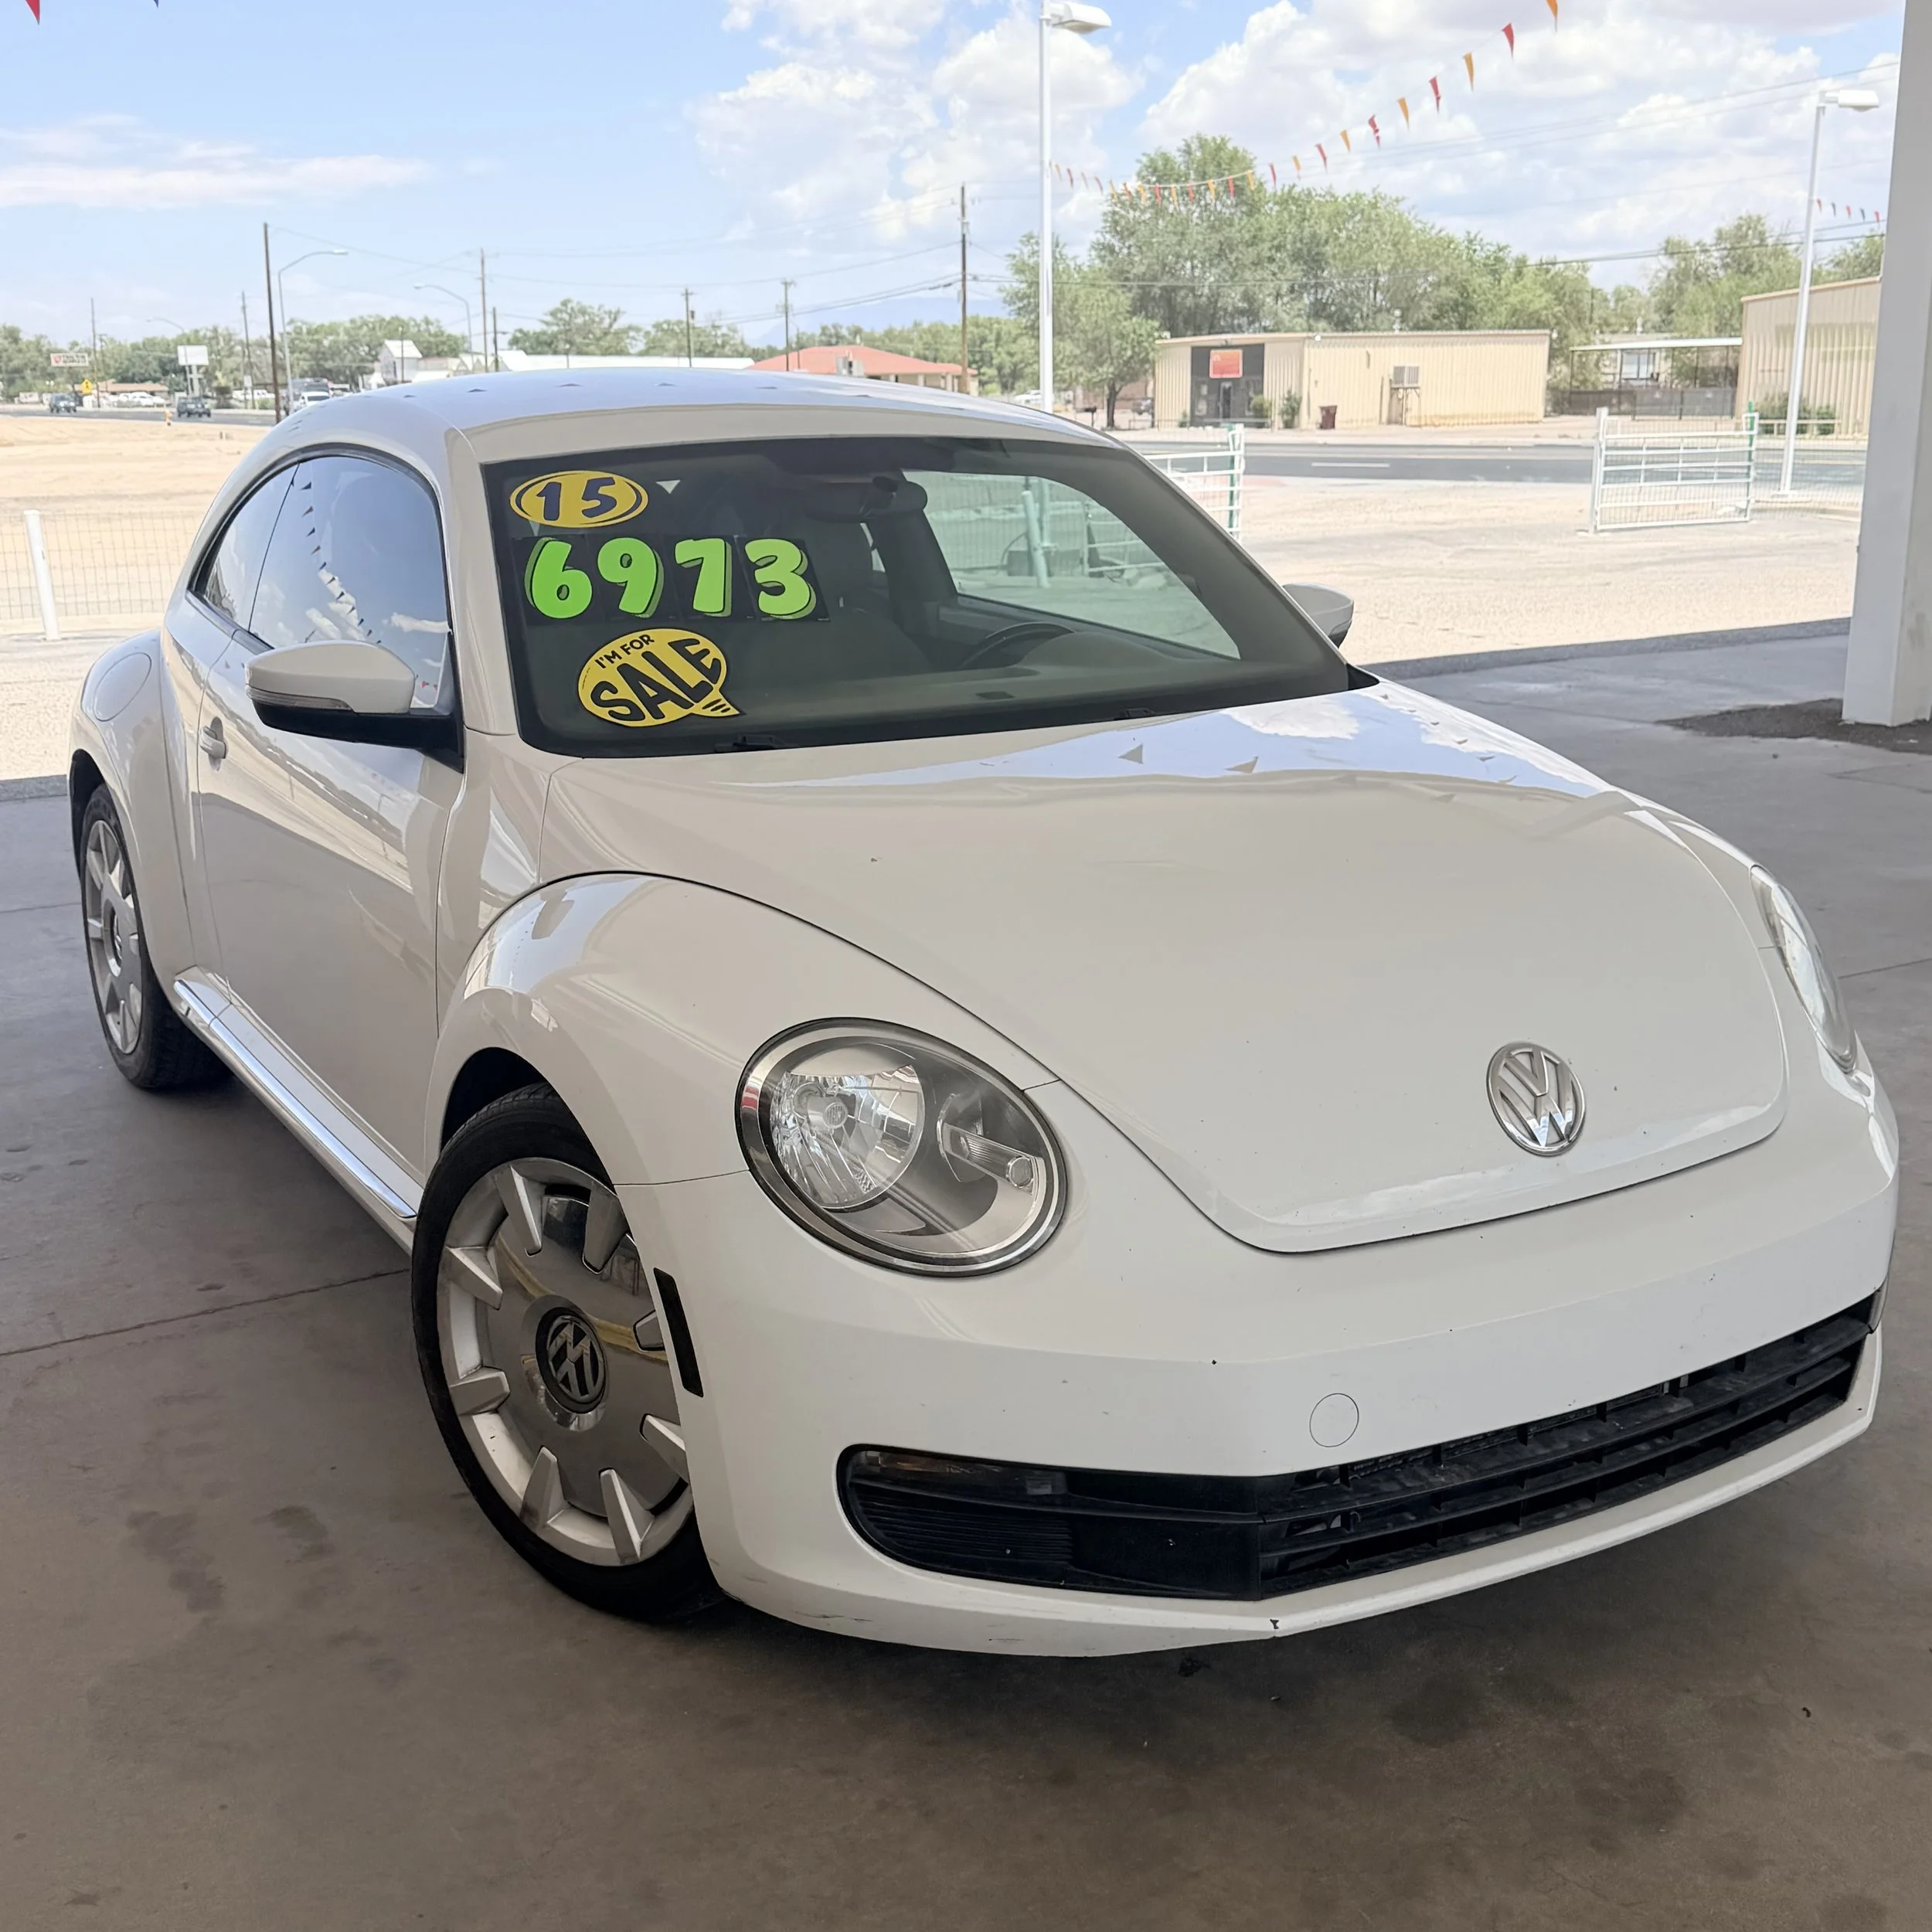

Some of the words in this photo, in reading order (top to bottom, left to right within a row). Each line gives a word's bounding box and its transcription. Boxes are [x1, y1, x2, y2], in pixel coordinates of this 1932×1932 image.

[536, 477, 617, 522] 15
[524, 537, 817, 619] 6973
[590, 638, 723, 722] SALE
[594, 650, 623, 669] I'M
[620, 634, 655, 655] FOR
[1490, 1043, 1583, 1154] VW
